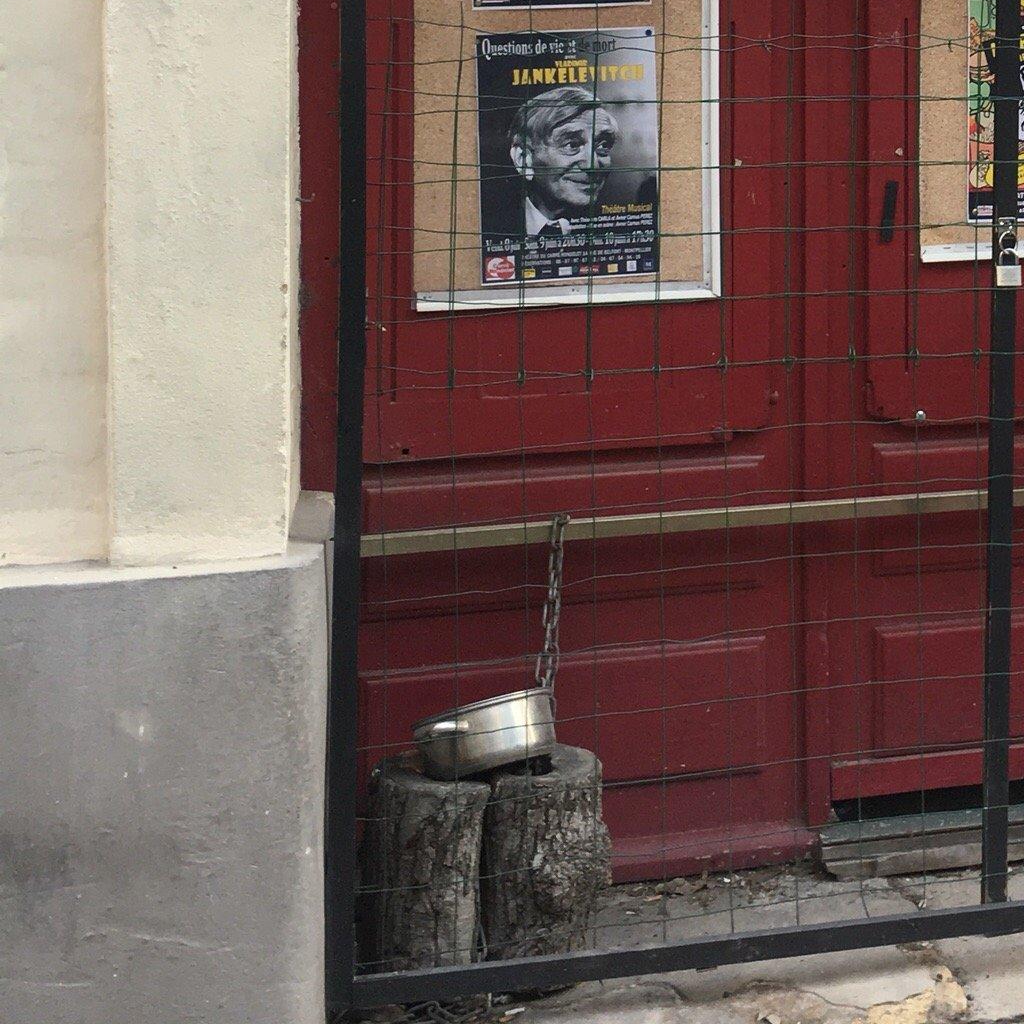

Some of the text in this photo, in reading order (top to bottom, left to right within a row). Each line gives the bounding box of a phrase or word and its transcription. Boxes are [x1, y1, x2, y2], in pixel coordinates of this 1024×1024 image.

[482, 38, 533, 60] Questions
[535, 39, 547, 55] de
[511, 64, 644, 86] JANKELEVITCH
